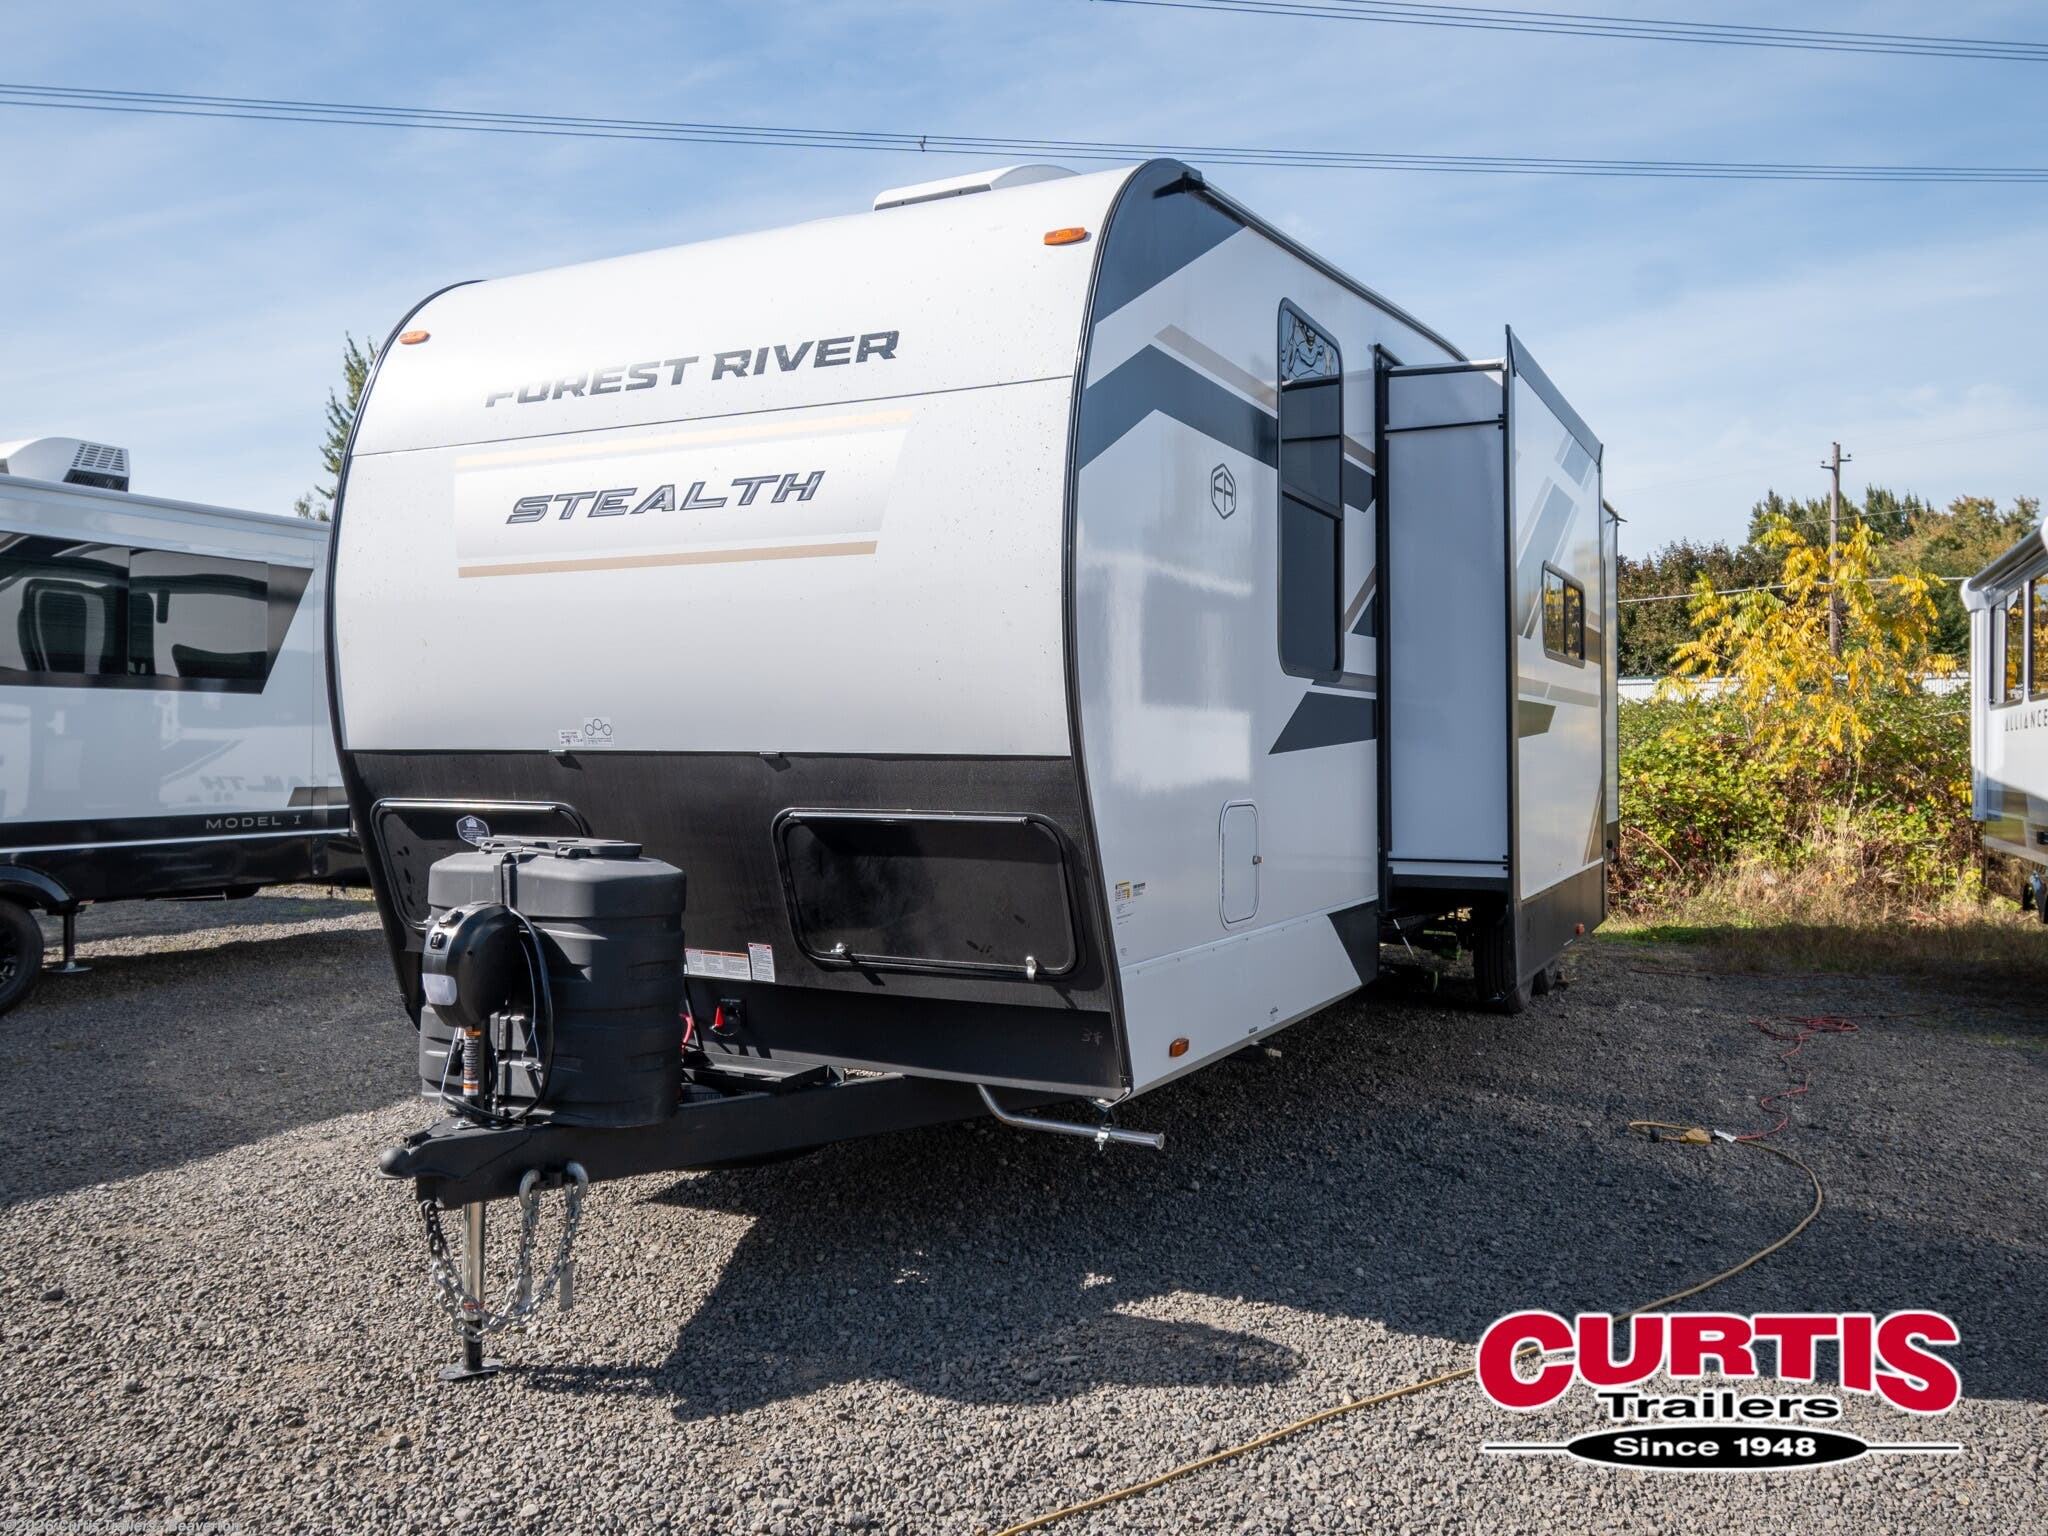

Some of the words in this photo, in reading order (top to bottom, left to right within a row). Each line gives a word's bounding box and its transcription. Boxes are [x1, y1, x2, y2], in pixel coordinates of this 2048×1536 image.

[711, 330, 900, 381] RIVER
[505, 470, 826, 525] STEALTH
[205, 816, 282, 830] MODEL
